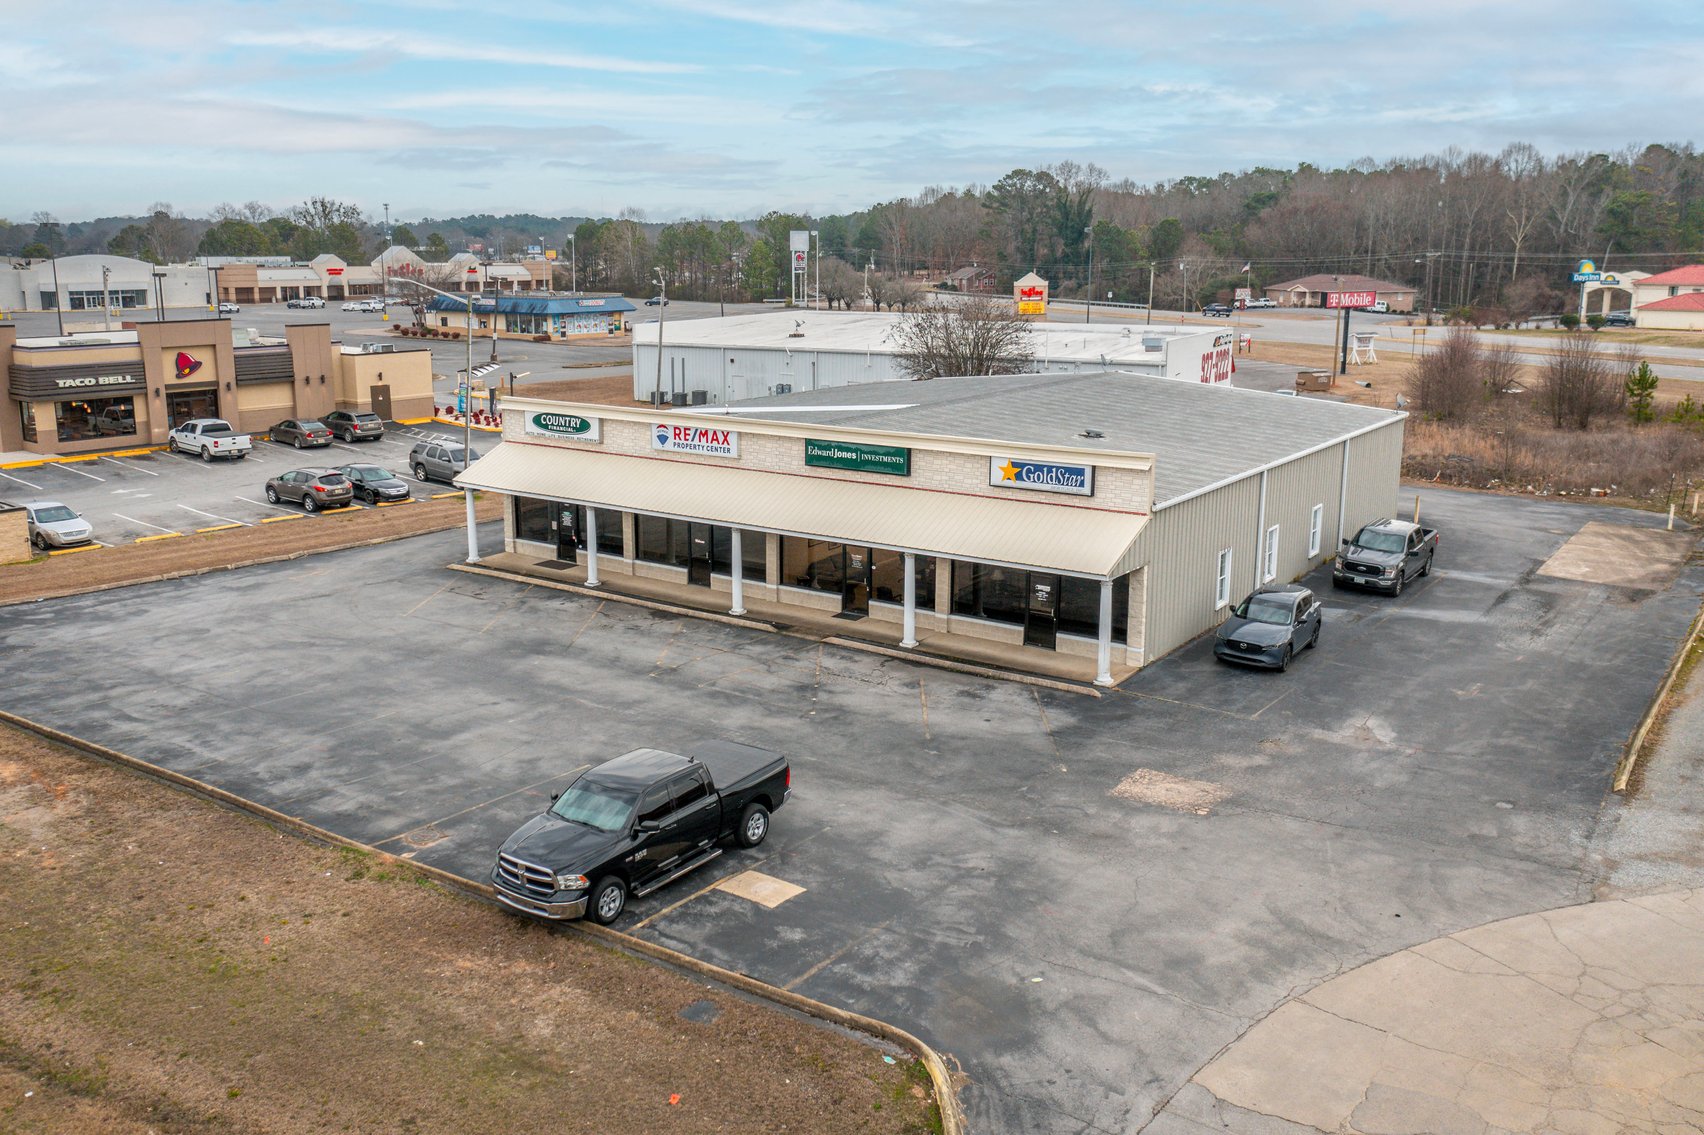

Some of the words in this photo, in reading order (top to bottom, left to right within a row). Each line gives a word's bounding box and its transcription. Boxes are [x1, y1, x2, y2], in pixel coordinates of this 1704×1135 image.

[56, 377, 97, 388] TACO
[98, 375, 136, 385] BELL
[541, 415, 582, 428] COUNTRY
[673, 427, 731, 446] RE/MAX
[673, 441, 705, 451] PROPERTY
[706, 445, 731, 454] CENTER
[861, 453, 904, 464] INVESTMENTS
